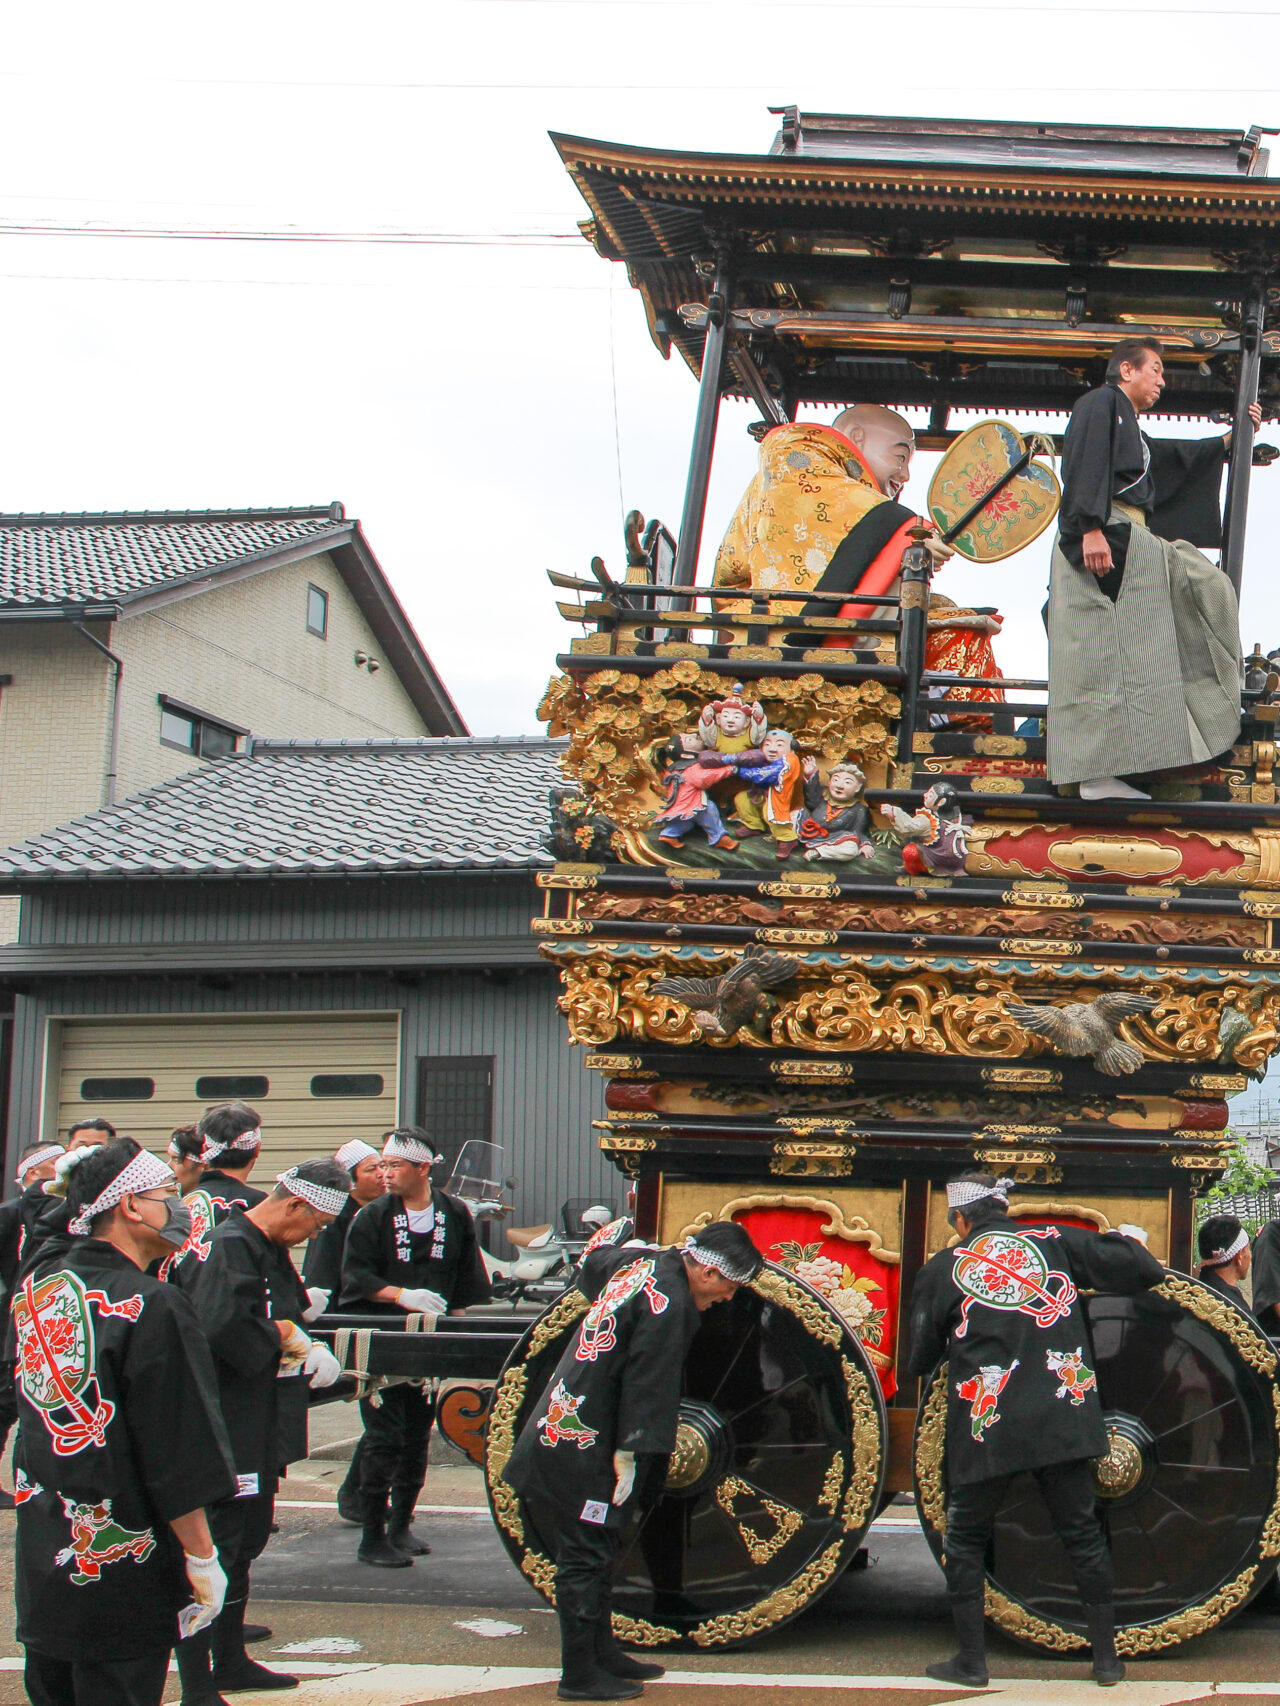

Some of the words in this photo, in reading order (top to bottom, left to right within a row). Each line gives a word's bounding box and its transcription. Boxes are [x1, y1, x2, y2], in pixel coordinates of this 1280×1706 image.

[393, 1214, 411, 1262] 出丸町
[430, 1210, 447, 1260] 布袋組
